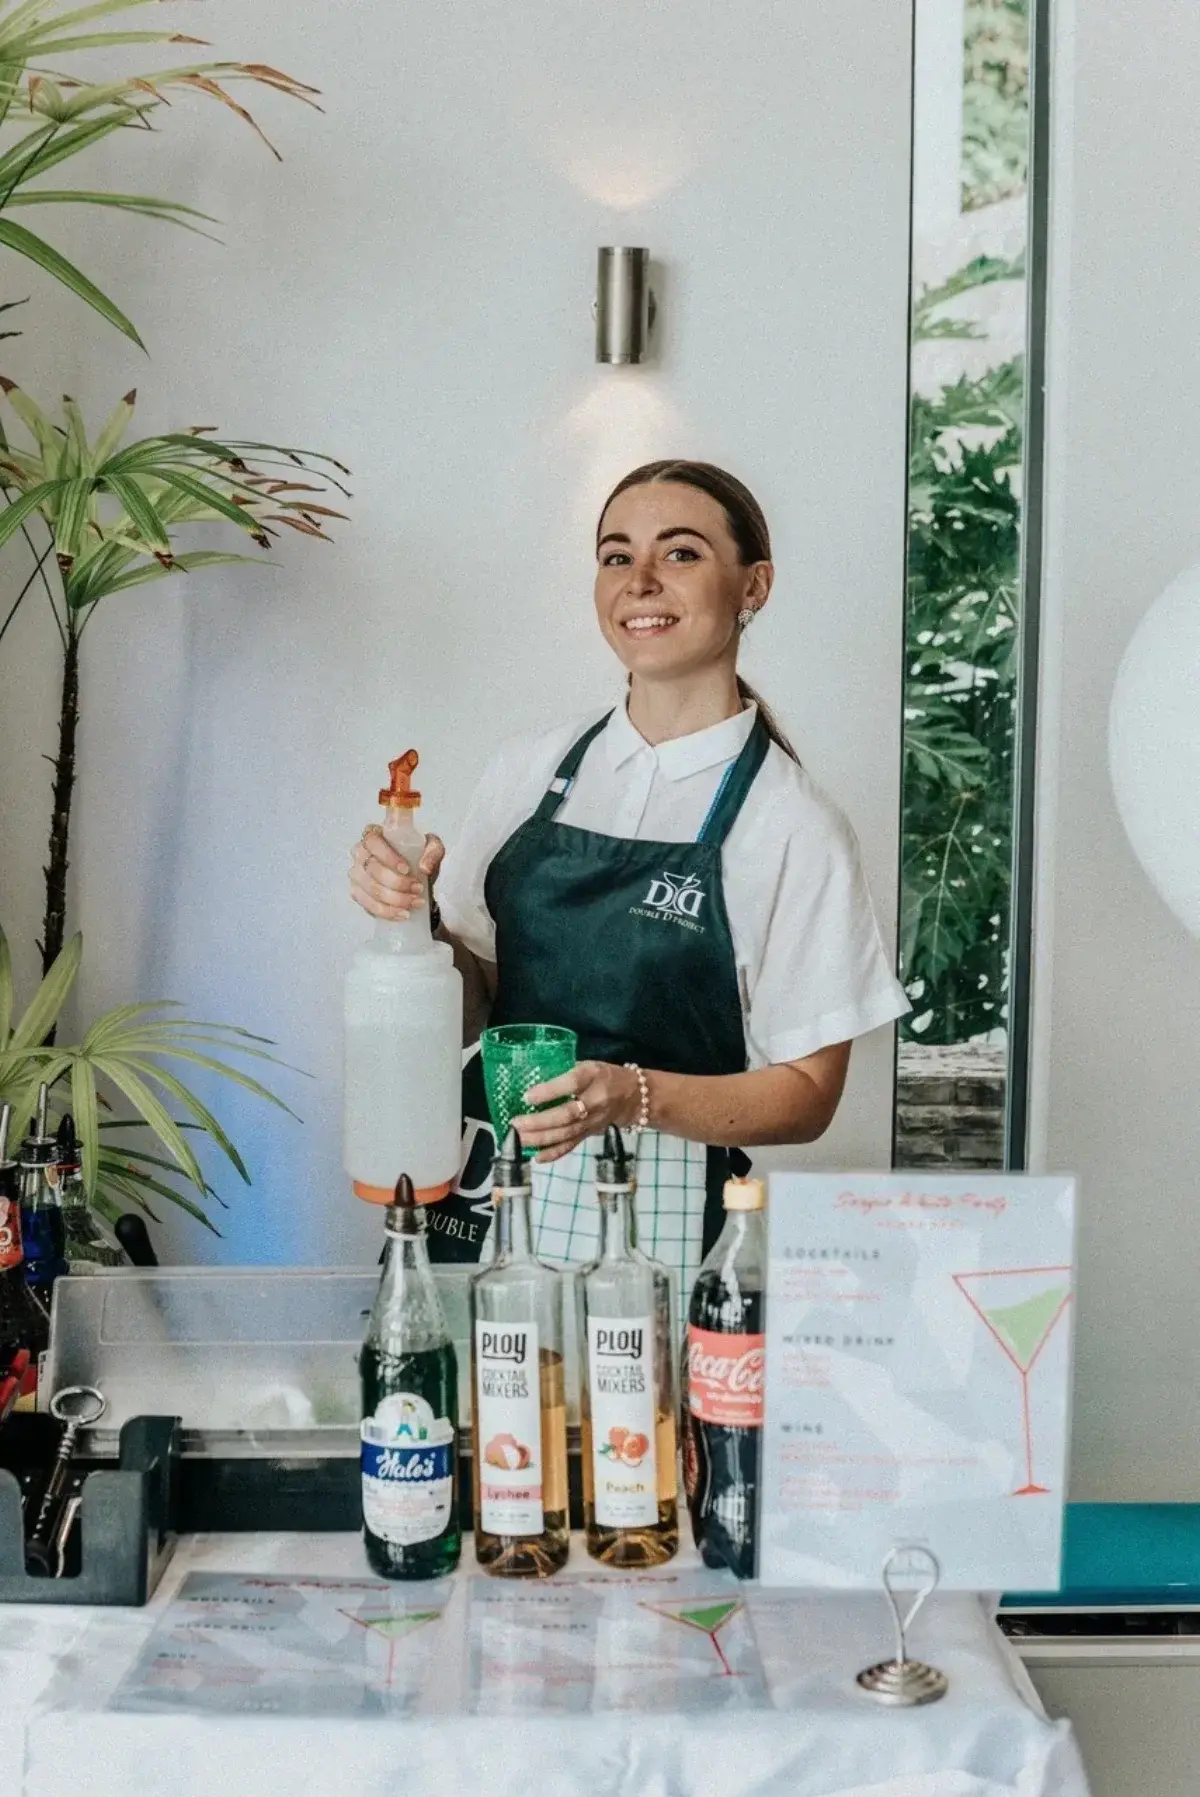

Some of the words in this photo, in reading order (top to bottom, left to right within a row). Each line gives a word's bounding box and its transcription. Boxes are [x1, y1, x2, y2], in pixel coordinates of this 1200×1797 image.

[628, 906, 660, 919] DOUBLE
[662, 911, 673, 921] D
[672, 916, 706, 934] PROJECT
[425, 1209, 479, 1243] OUBLE
[481, 1367, 528, 1382] COCKTAIL
[595, 1364, 644, 1379] COCKTAIL
[482, 1382, 529, 1399] MIXERS
[597, 1378, 646, 1394] MIXERS
